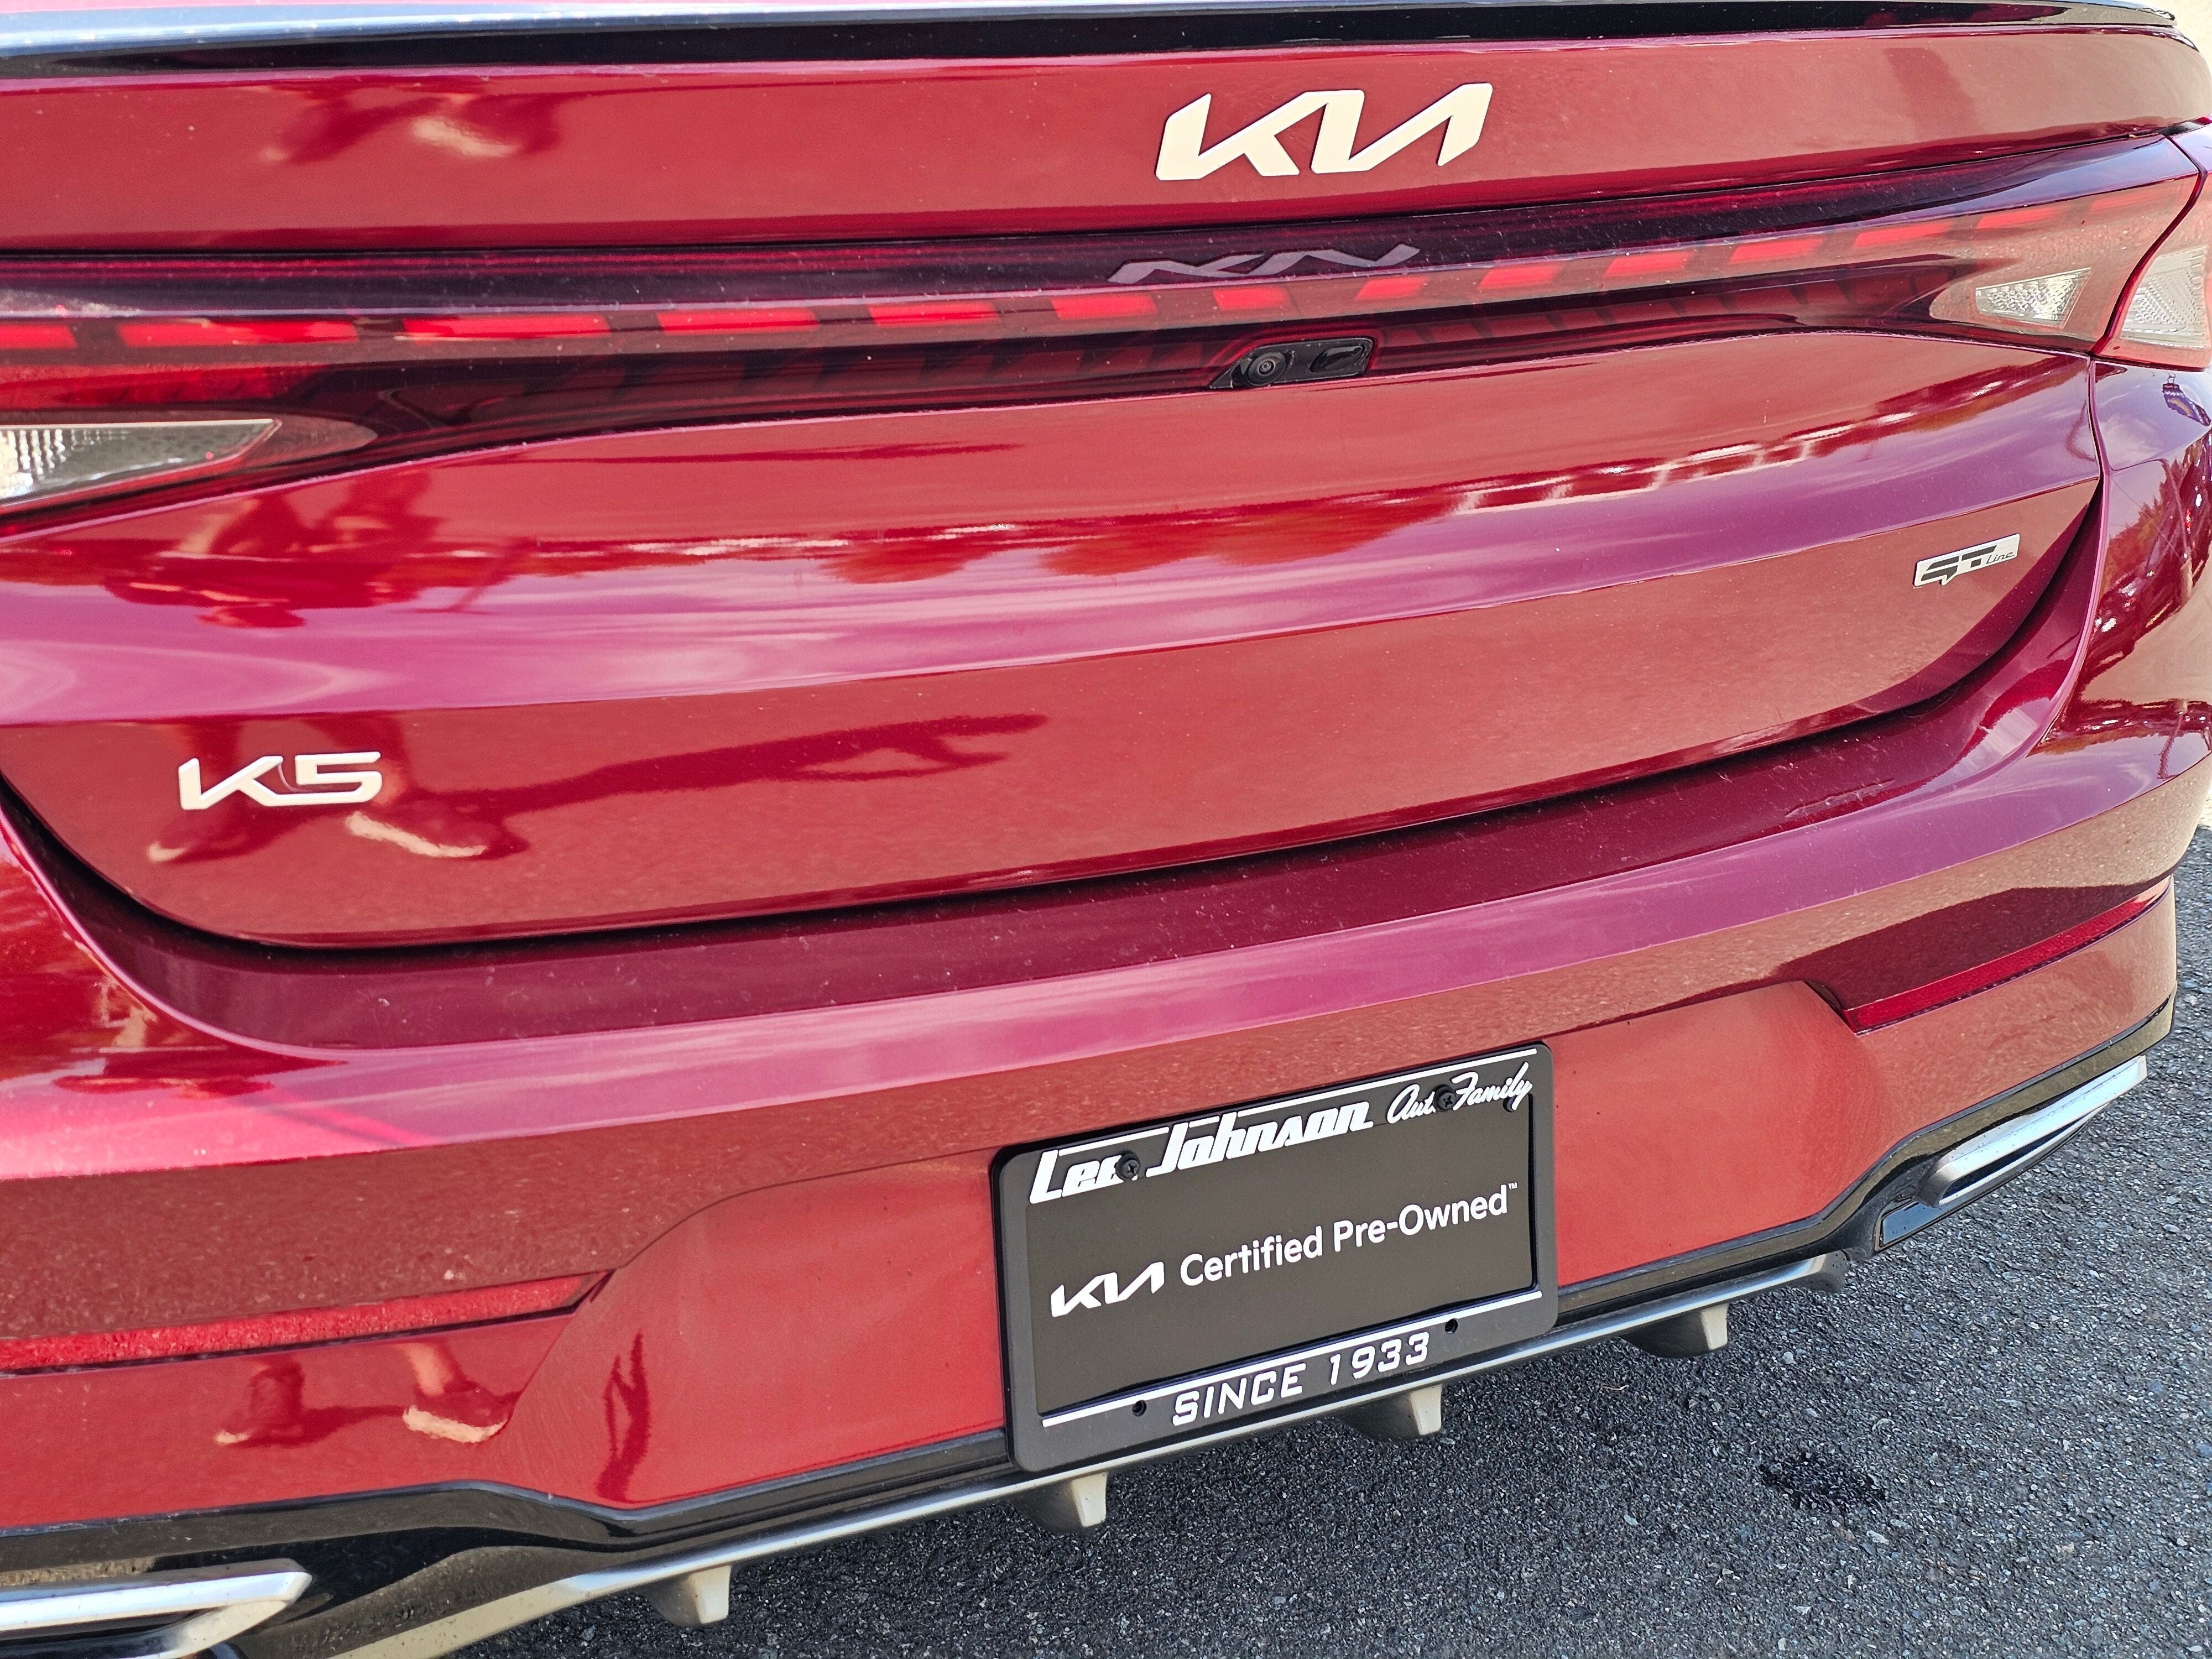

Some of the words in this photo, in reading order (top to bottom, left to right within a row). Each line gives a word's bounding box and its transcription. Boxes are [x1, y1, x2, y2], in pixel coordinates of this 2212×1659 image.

[1155, 82, 1493, 181] KIA
[178, 751, 383, 811] K5
[1145, 1100, 1374, 1178] Johnson
[1387, 1083, 1439, 1124] Aut
[1451, 1061, 1533, 1111] Family
[1050, 1261, 1165, 1318] KIA
[1180, 1225, 1323, 1286] Certified
[1172, 1363, 1307, 1426] SINCE
[1330, 1332, 1430, 1385] 1933
